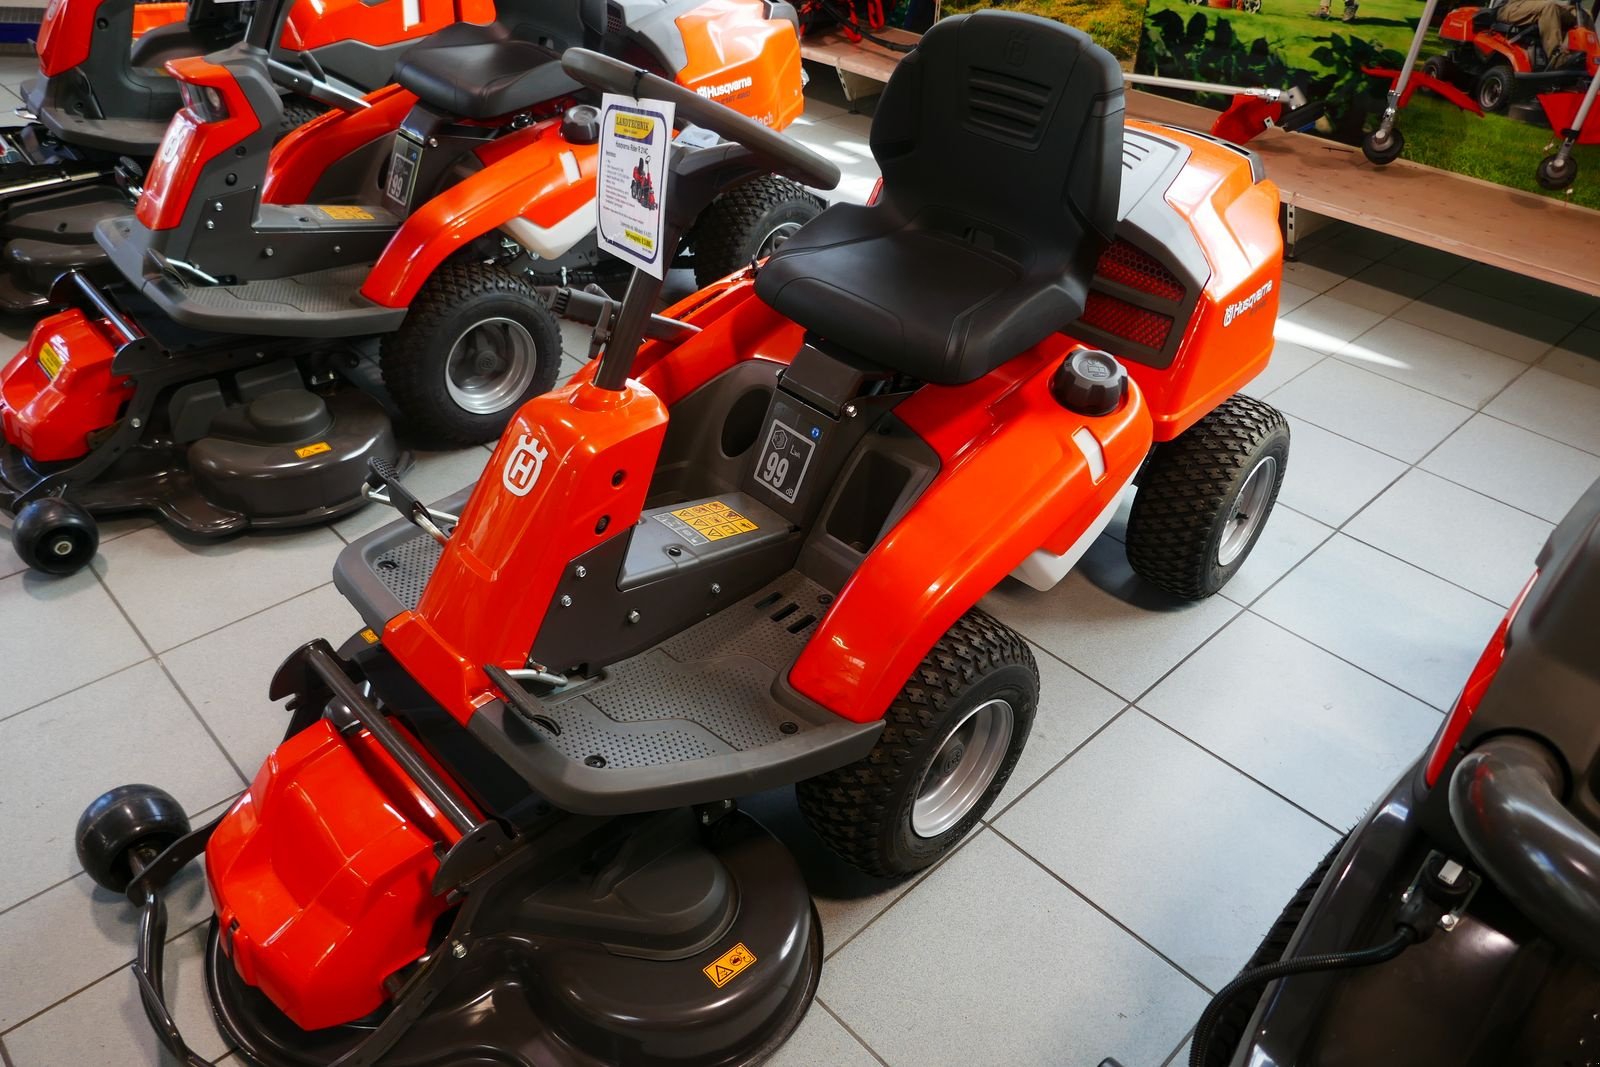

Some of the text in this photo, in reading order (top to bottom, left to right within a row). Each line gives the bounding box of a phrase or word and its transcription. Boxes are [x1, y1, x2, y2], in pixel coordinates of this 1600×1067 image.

[707, 77, 752, 99] Husqvarna
[616, 116, 649, 131] LANDTECHNIK
[391, 175, 403, 197] 99
[1233, 280, 1273, 319] Husqvarna
[763, 452, 789, 488] 99
[786, 488, 794, 497] dB
